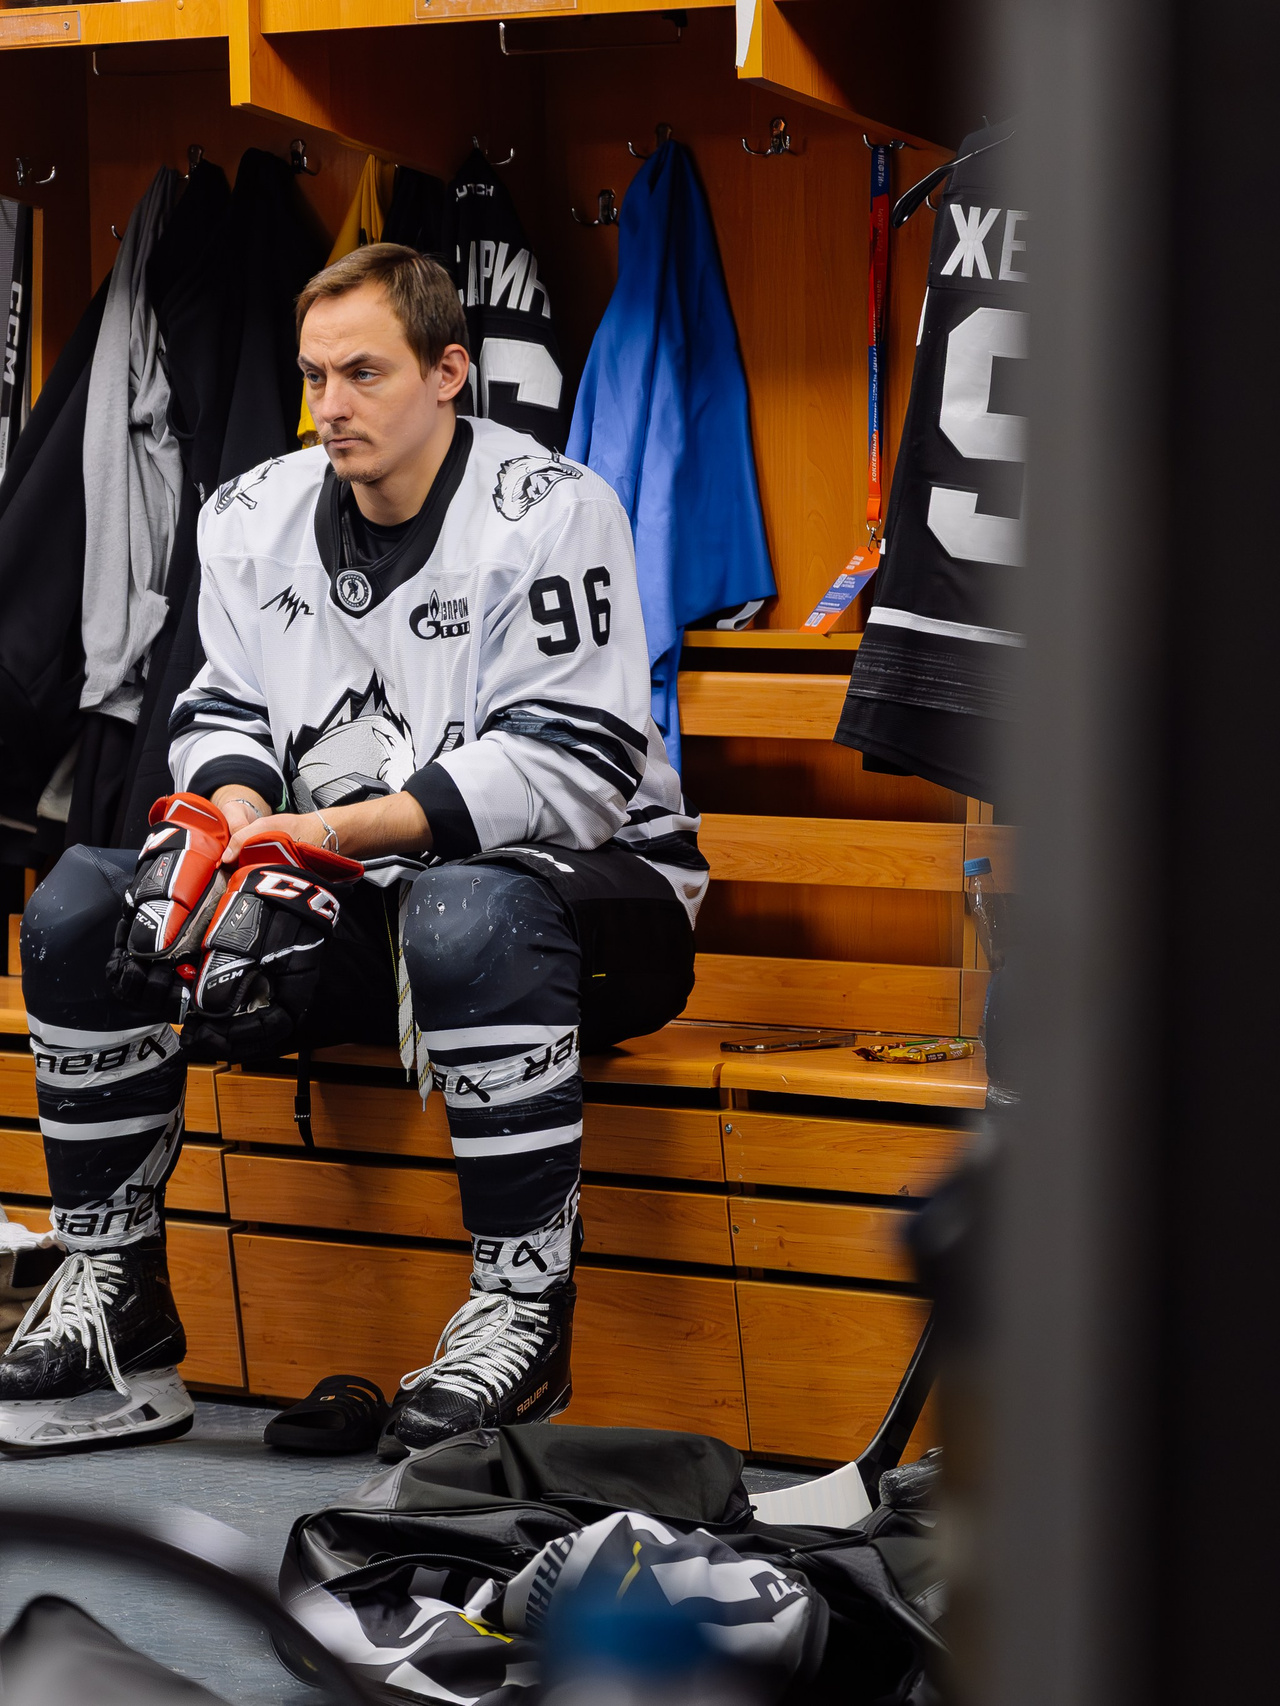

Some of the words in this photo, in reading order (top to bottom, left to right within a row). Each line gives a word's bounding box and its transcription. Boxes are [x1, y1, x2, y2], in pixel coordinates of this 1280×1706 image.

[3, 280, 23, 387] CCM
[528, 565, 612, 657] 96
[253, 869, 341, 929] CC
[206, 968, 245, 990] CCM
[516, 1380, 549, 1417] BAUER
